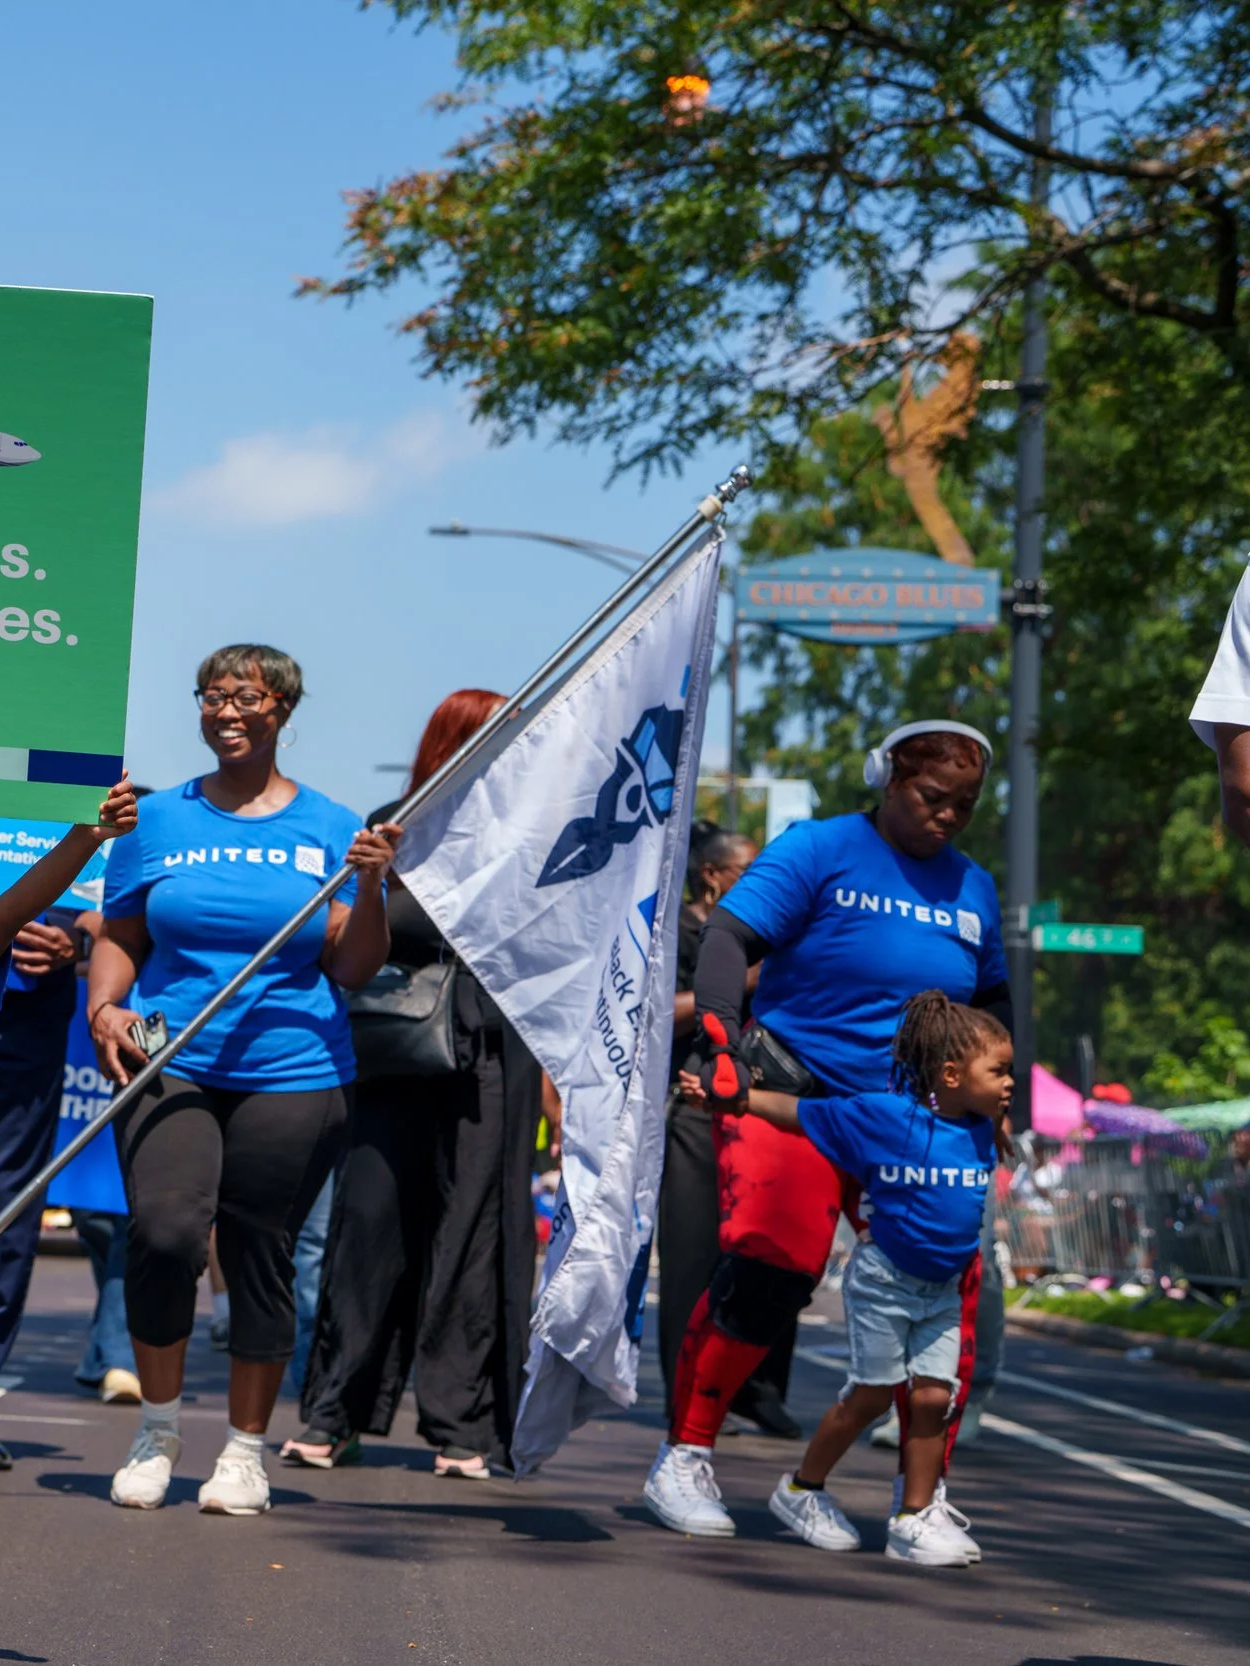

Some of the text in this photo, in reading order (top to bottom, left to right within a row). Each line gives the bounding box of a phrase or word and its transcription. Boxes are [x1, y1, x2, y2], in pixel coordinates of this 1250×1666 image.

[750, 581, 985, 610] CHICAGO BLUES
[164, 848, 288, 867] UNITED
[835, 888, 953, 927] UNITED
[879, 1165, 989, 1187] UNITED
